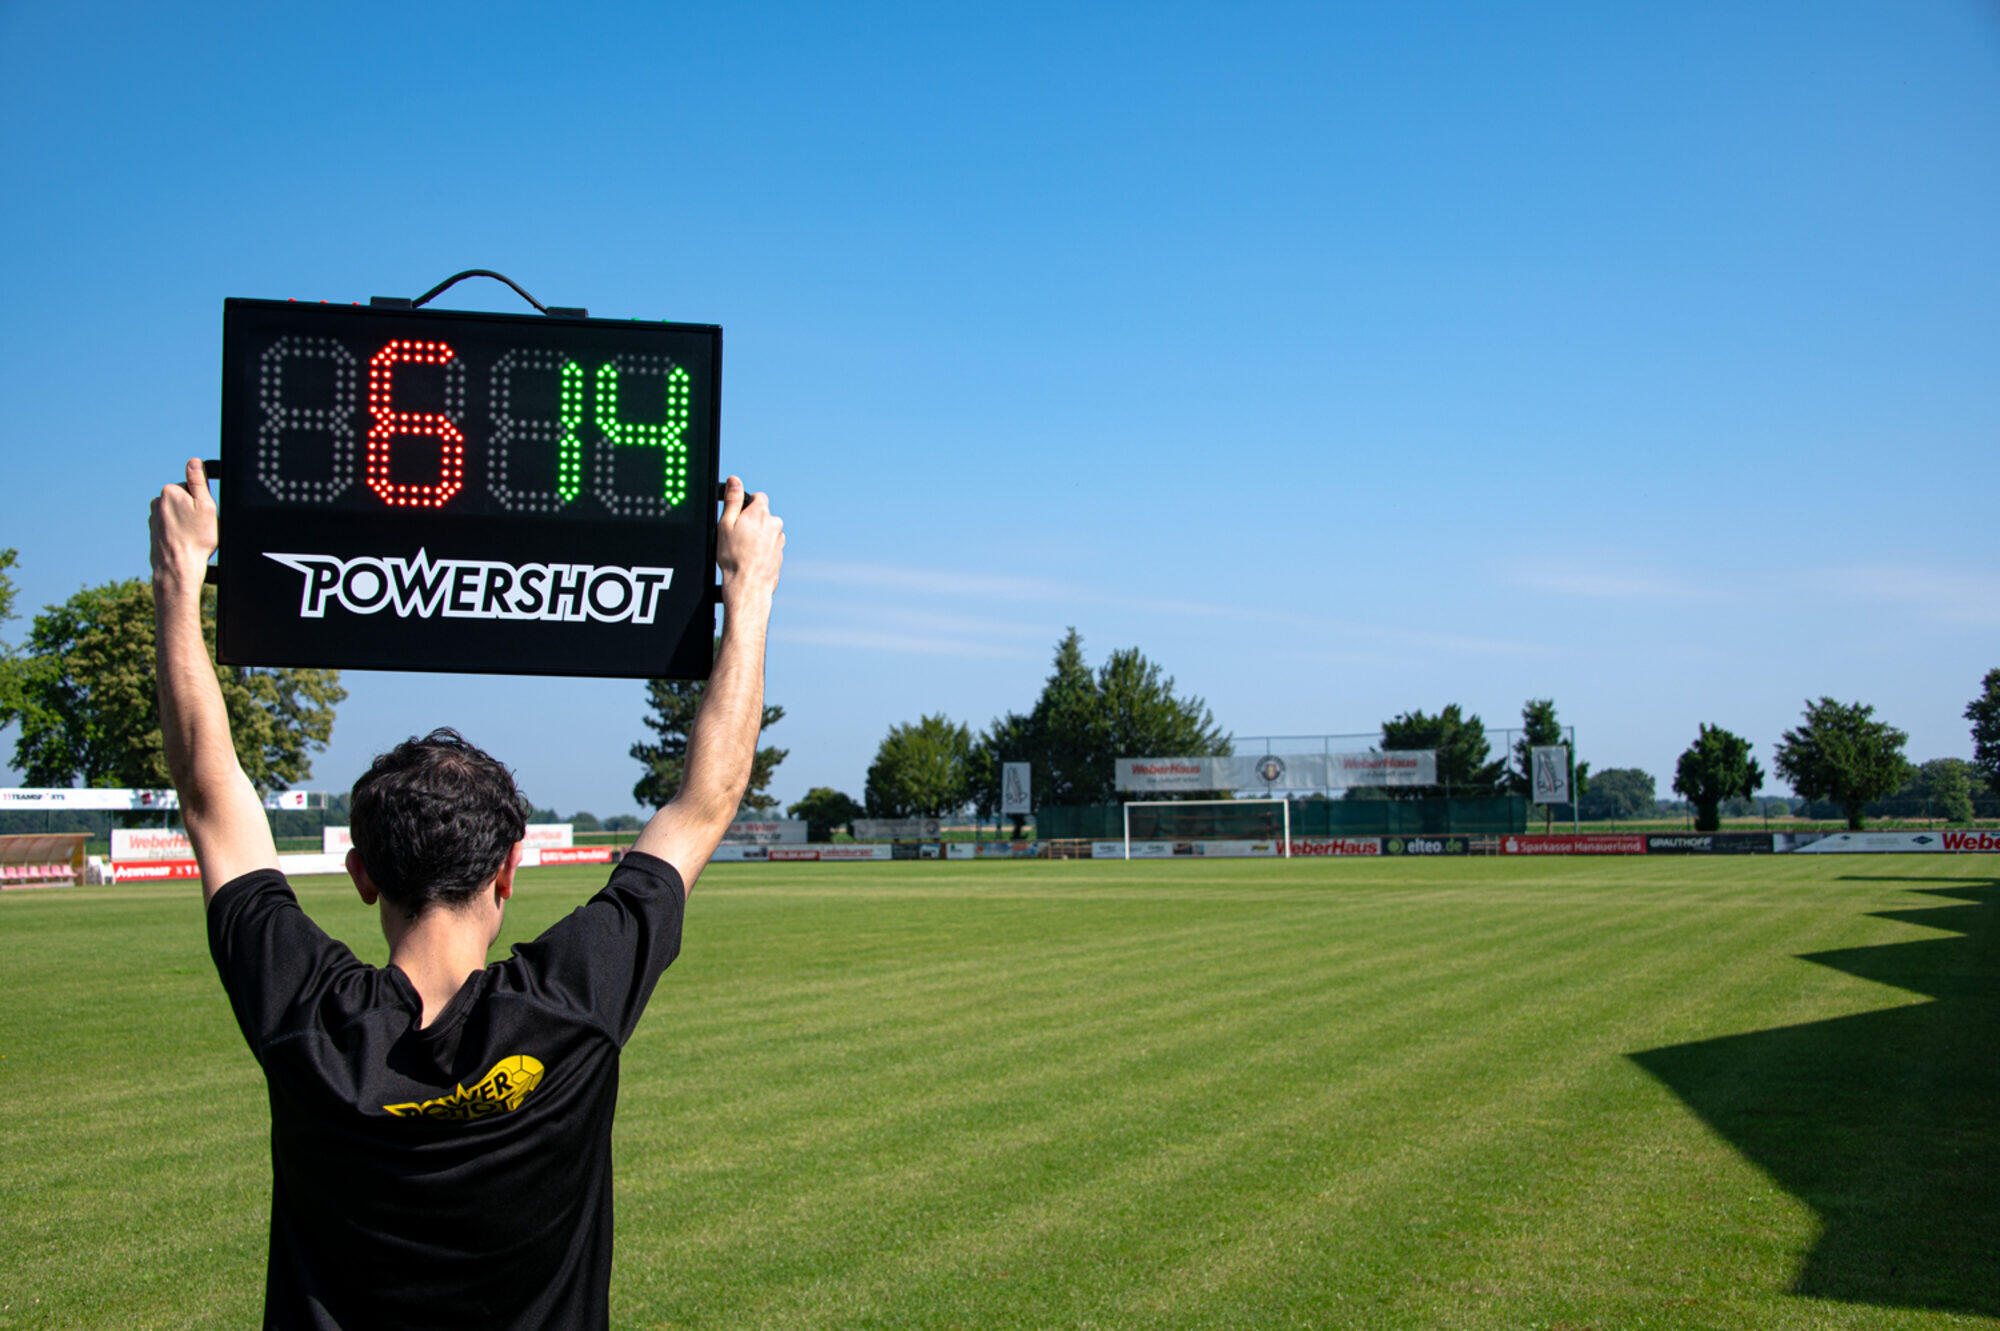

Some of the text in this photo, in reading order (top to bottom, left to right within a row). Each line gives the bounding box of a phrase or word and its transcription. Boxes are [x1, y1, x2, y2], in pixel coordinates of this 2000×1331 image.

[366, 339, 691, 509] 6 14
[262, 547, 674, 624] POWERSHOT
[1131, 763, 1201, 776] WeberHaus
[1275, 838, 1378, 856] WeberHaus
[1407, 838, 1464, 853] elteo.de
[1520, 840, 1641, 854] Sparkasse Hanauerland
